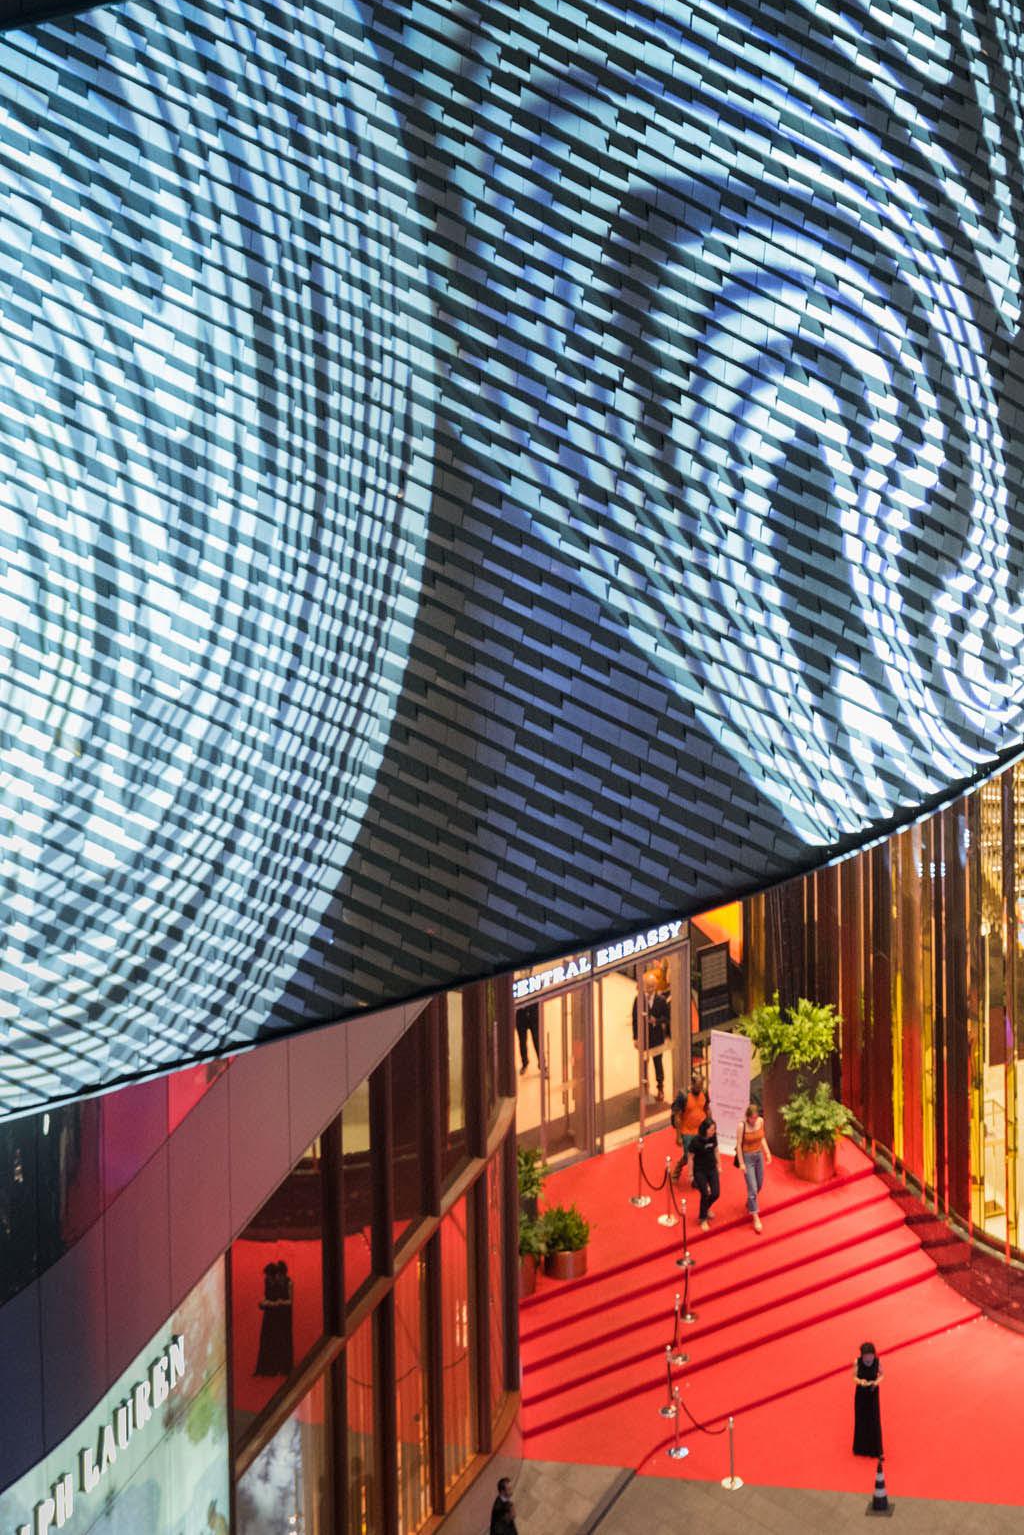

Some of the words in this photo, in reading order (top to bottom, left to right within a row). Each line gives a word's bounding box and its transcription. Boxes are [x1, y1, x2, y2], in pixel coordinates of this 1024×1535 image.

[597, 920, 682, 966] EMBASSY
[18, 1473, 74, 1535] PH
[80, 1334, 185, 1493] LAUREN
